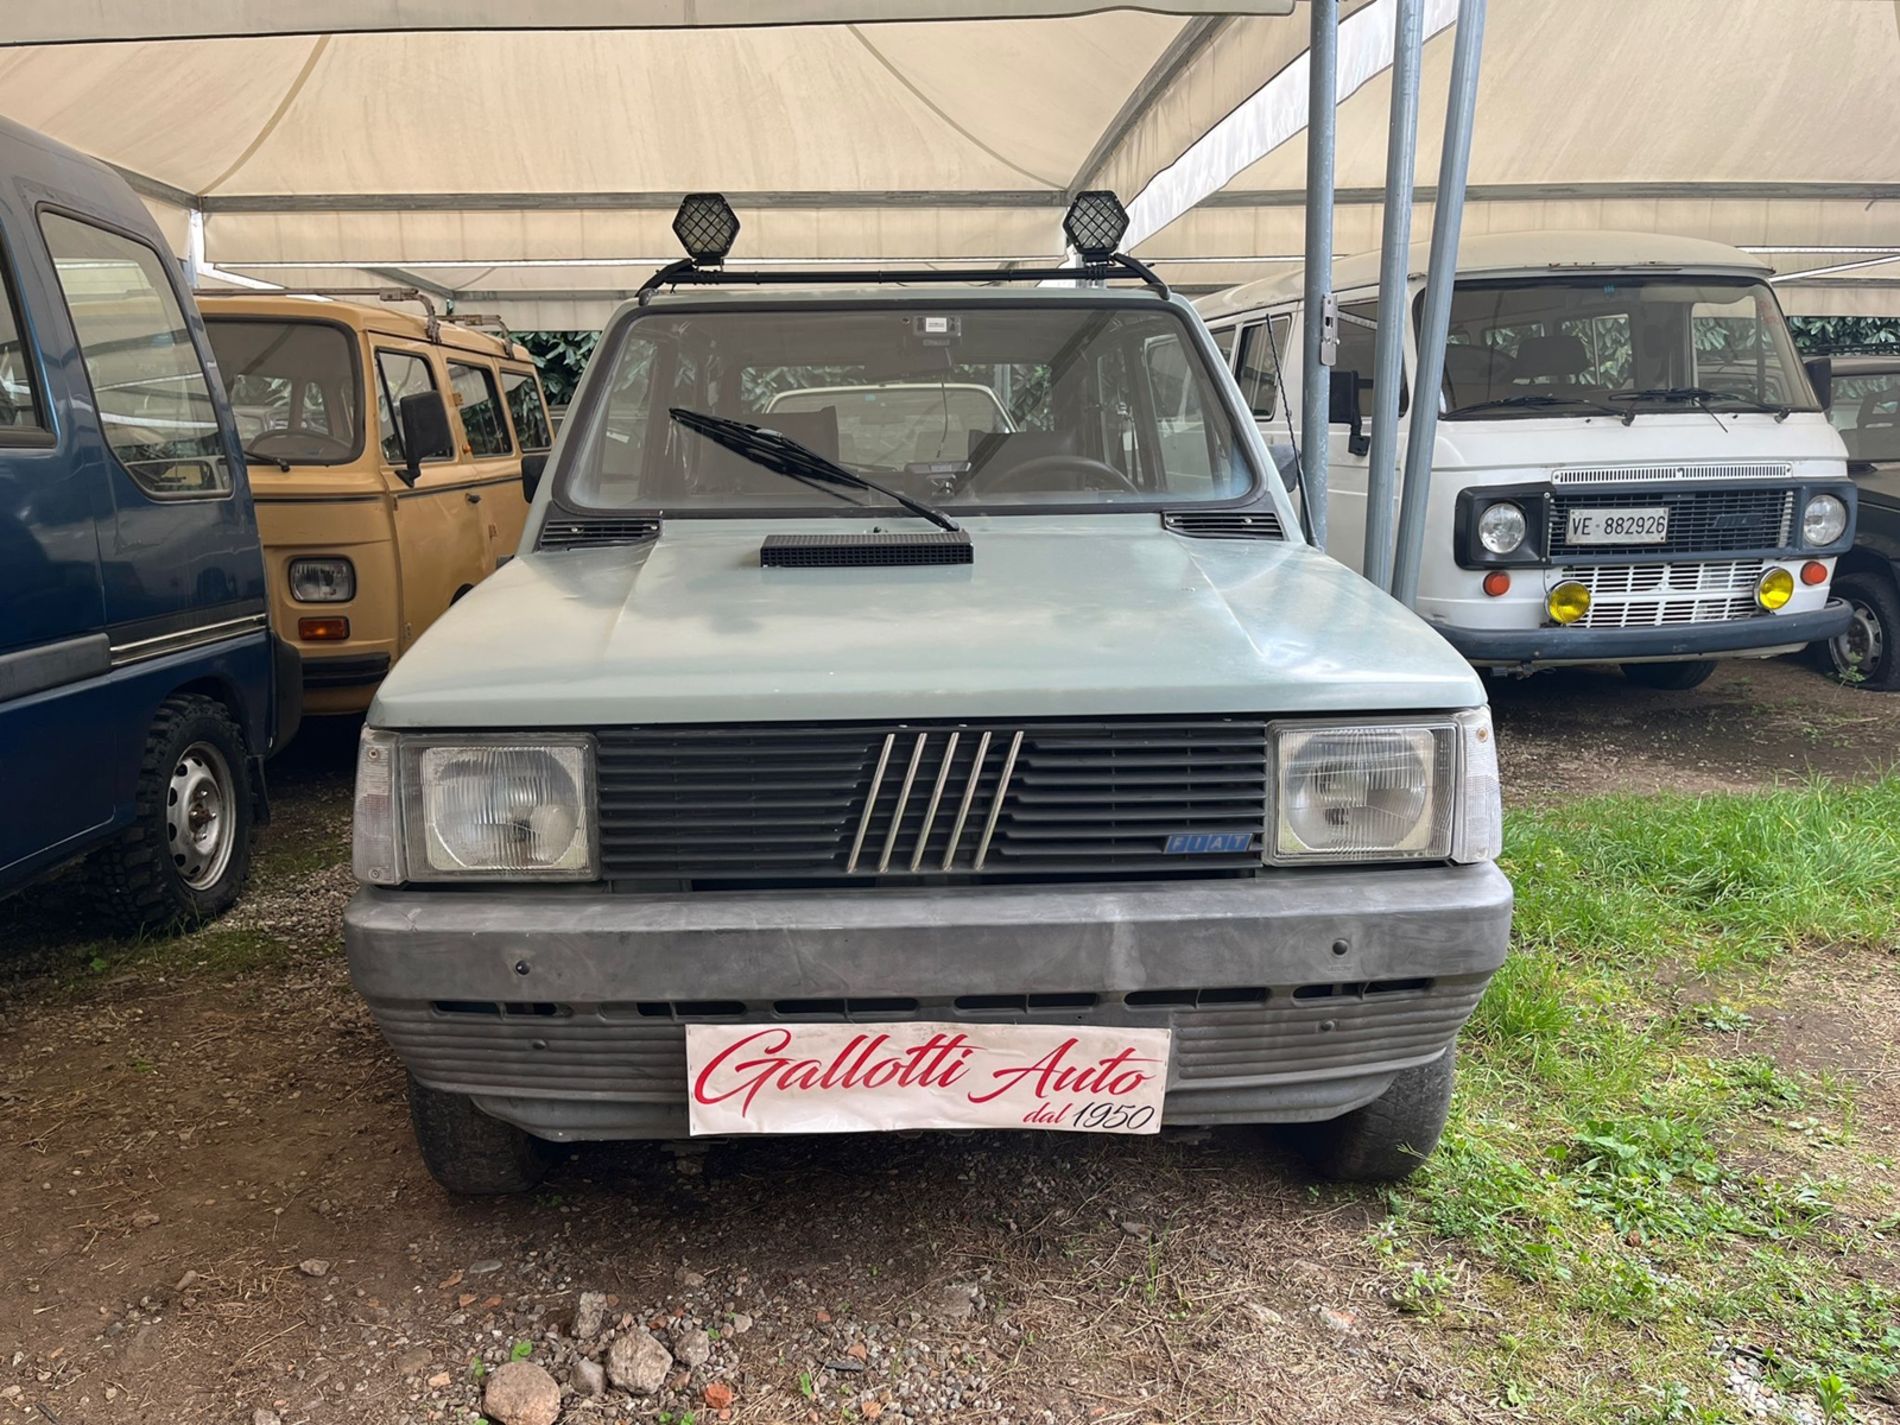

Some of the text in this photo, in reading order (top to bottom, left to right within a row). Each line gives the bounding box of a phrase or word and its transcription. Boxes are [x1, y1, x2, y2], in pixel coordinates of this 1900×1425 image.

[1572, 515, 1666, 536] VE 882926
[1171, 835, 1246, 851] FIAT
[693, 1028, 1163, 1117] Gallotti Auto
[1023, 1101, 1156, 1129] dal 1950
